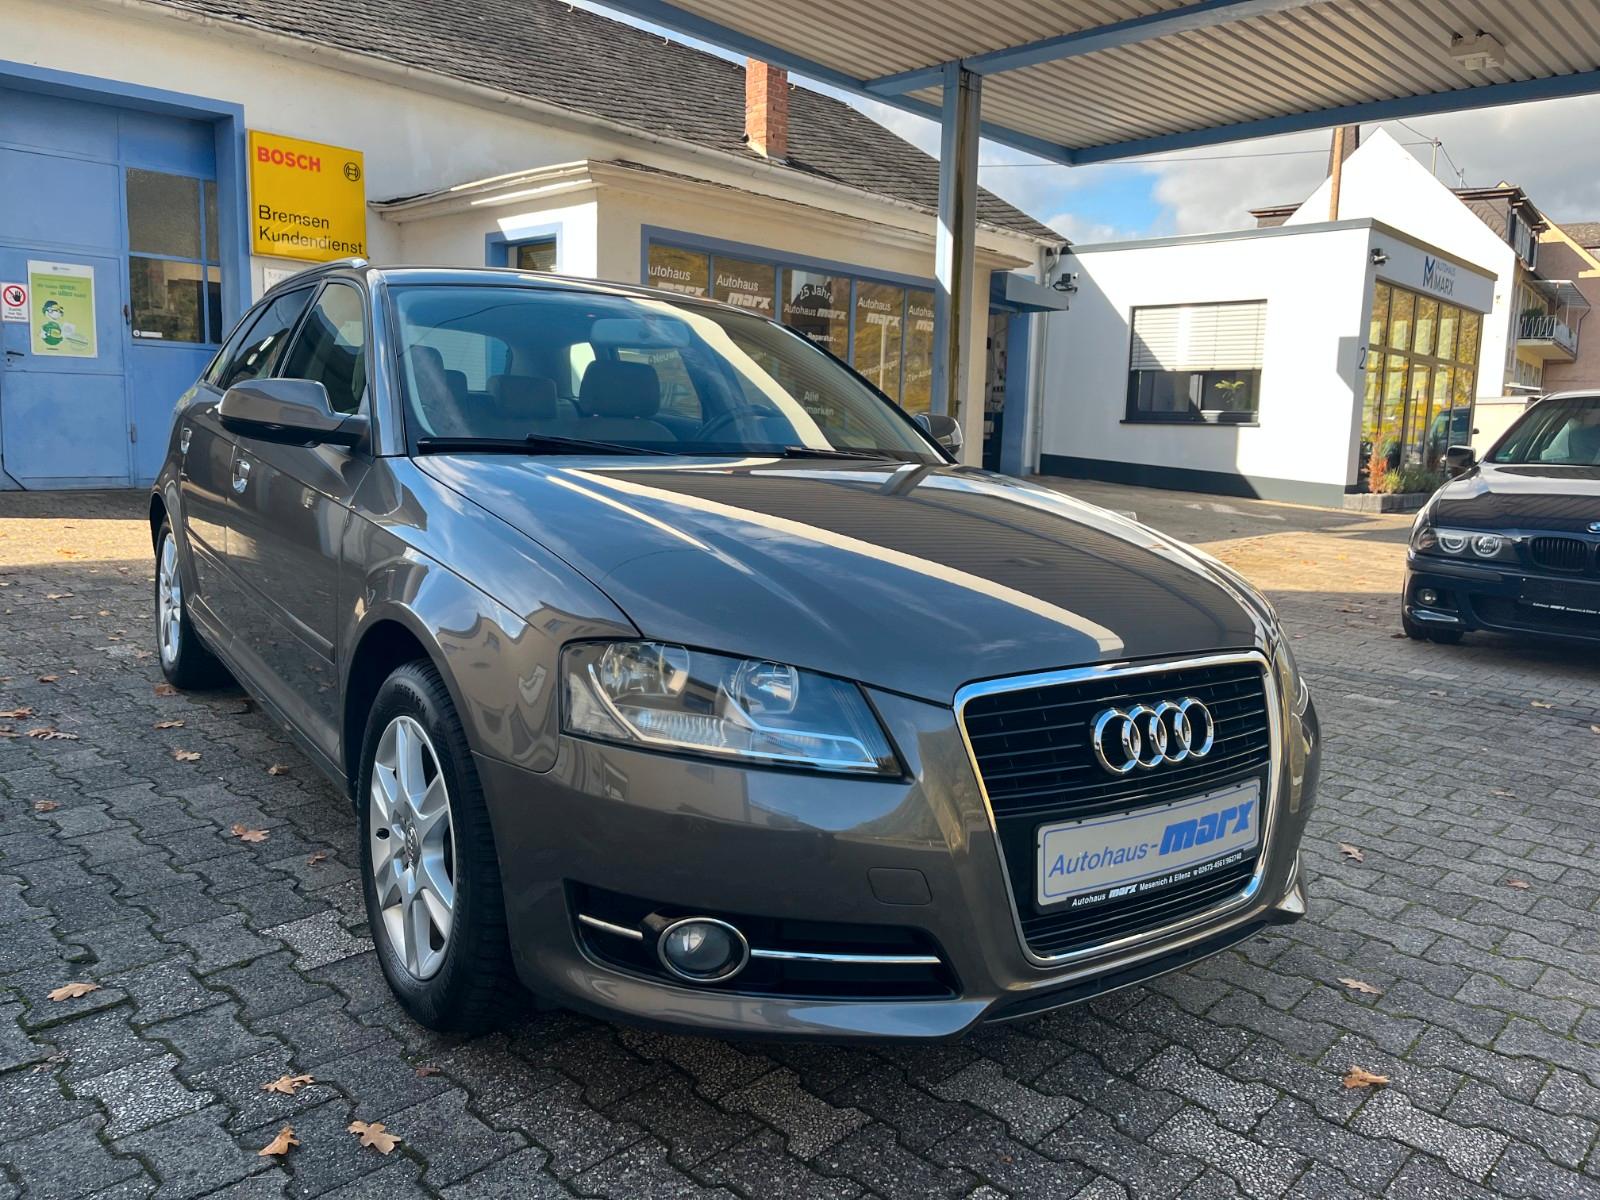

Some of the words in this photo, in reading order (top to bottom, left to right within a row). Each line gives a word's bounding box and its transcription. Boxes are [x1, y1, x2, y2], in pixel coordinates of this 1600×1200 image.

[257, 146, 321, 172] BOSCH
[258, 205, 330, 229] Bremsen
[259, 226, 364, 255] Kundendienst
[715, 274, 759, 291] Autohaus
[1433, 272, 1455, 297] MARX
[727, 292, 772, 310] marx
[799, 285, 810, 300] 25
[811, 285, 834, 304] Jahre
[783, 303, 816, 316] Autohaus
[817, 308, 848, 321] marx
[858, 297, 892, 312] Autohaus
[908, 304, 934, 318] Autohau
[866, 312, 902, 327] marx
[915, 319, 934, 332] ma
[1359, 346, 1366, 370] 2
[1072, 893, 1106, 907] Autohaus
[1108, 883, 1138, 899] marx
[1139, 877, 1169, 891] Mesenich
